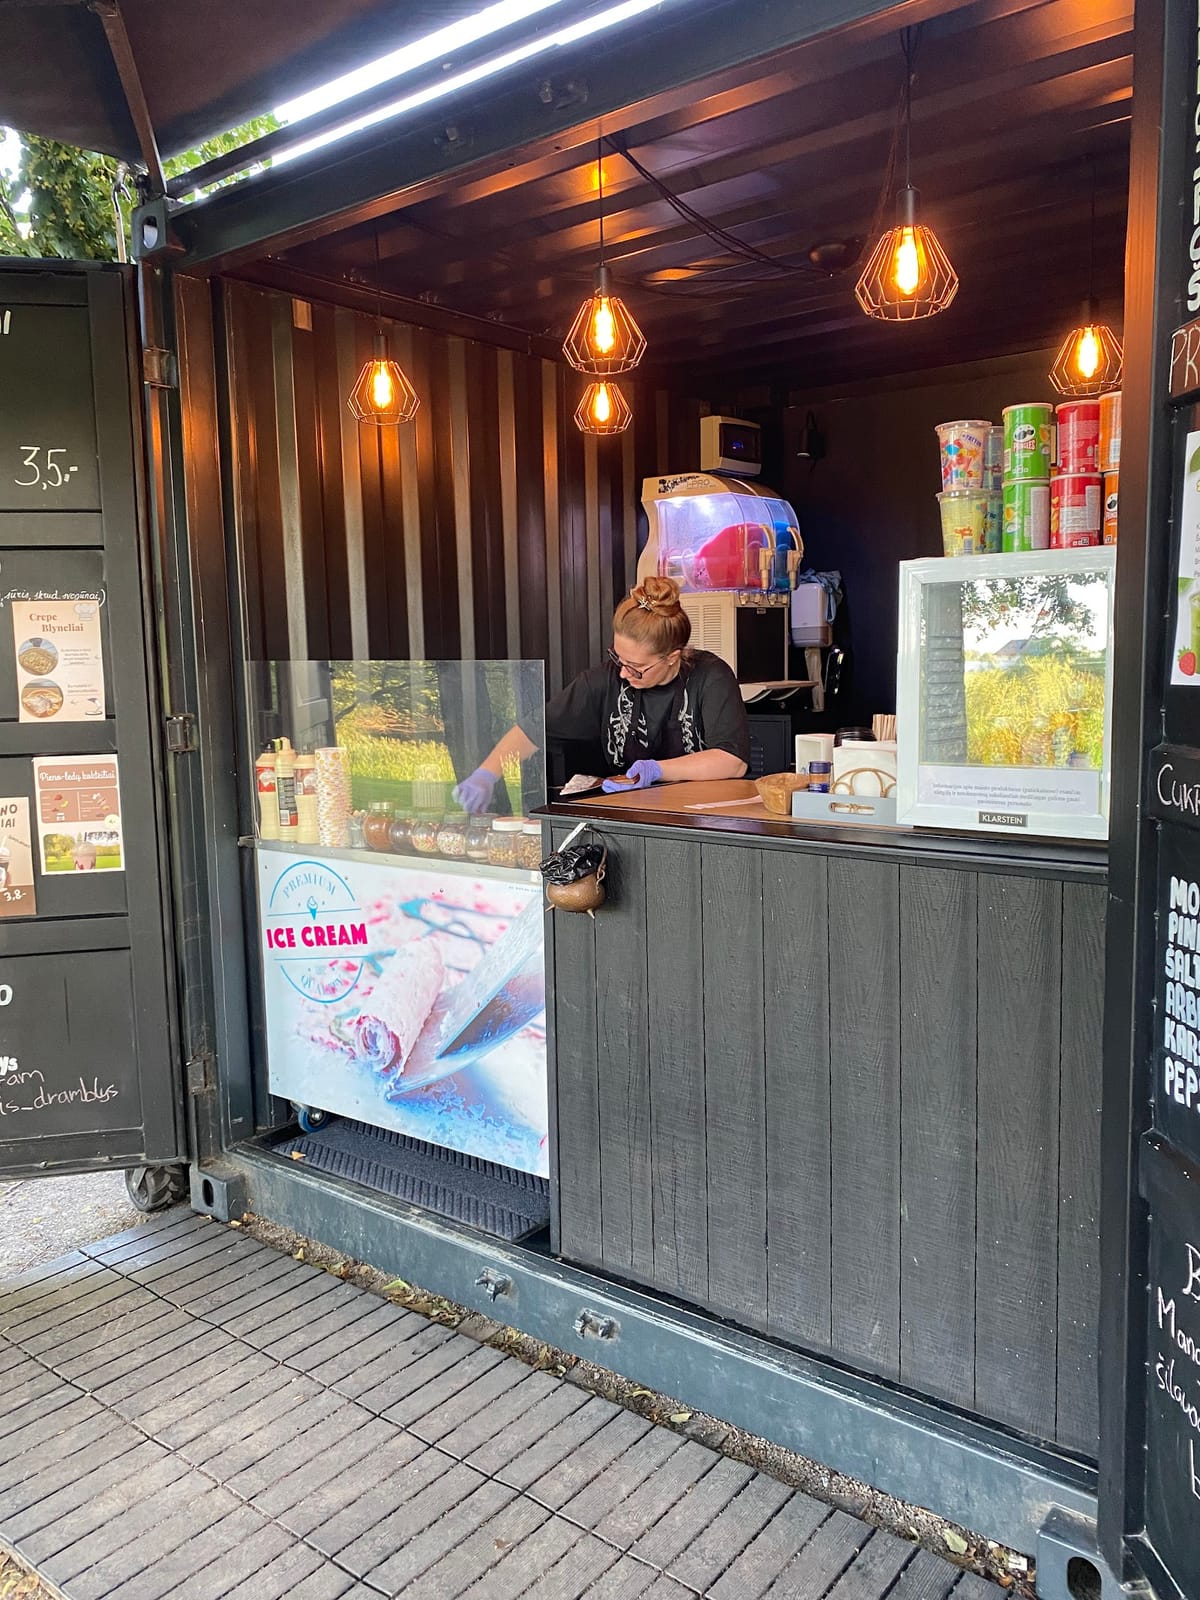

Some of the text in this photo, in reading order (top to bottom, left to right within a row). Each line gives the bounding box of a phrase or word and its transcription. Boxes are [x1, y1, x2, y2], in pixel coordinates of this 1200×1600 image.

[29, 613, 58, 622] Crepe
[42, 623, 84, 633] Blyneliai
[981, 814, 1024, 825] KLARSTEIN
[282, 872, 337, 899] PREMIUM
[266, 923, 368, 949] ICE CREAM
